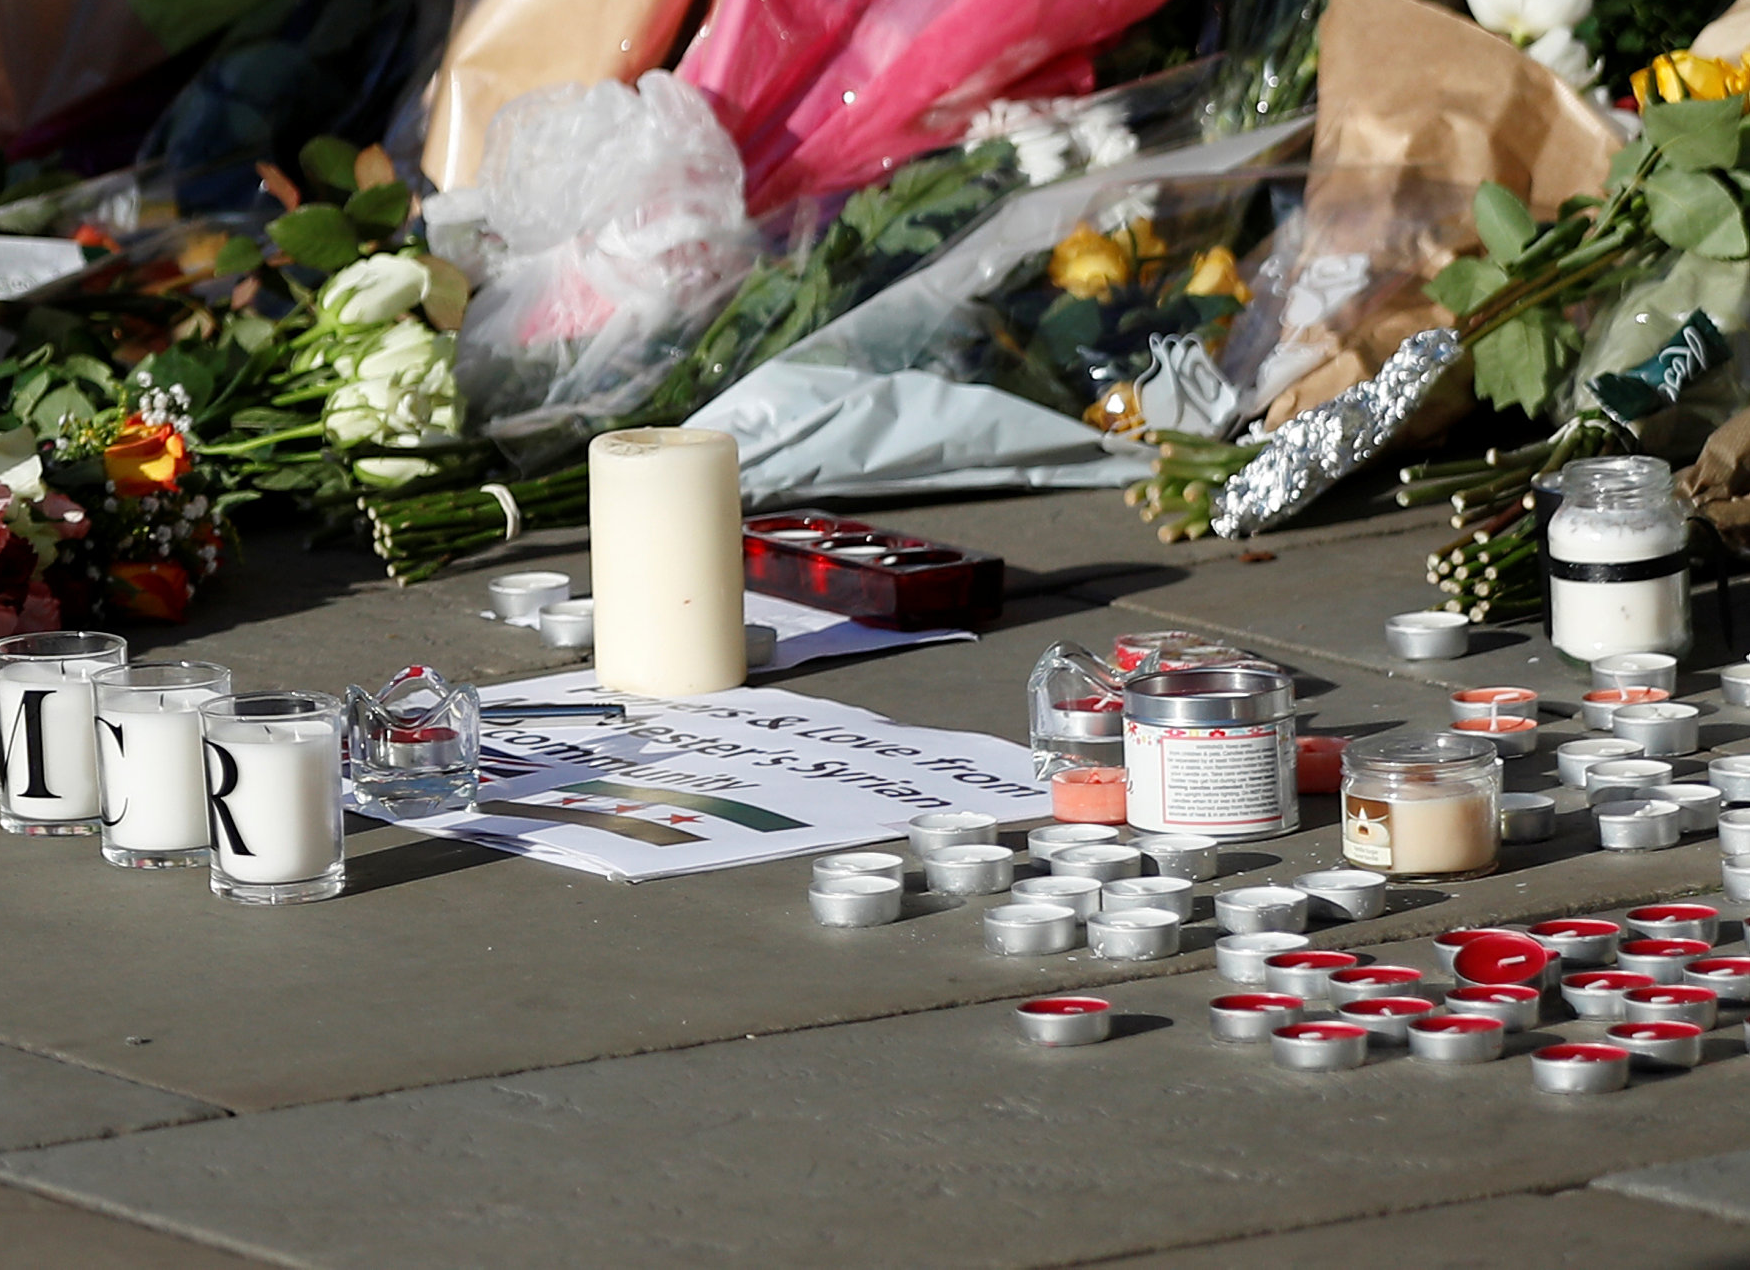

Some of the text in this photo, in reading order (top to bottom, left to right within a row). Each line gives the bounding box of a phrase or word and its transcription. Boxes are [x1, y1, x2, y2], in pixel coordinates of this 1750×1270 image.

[94, 715, 129, 828] C
[202, 736, 256, 857] R
[480, 729, 760, 792] community
[746, 715, 811, 730] &
[792, 726, 921, 758] Love
[912, 757, 1048, 798] from
[786, 759, 953, 809] Syrian
